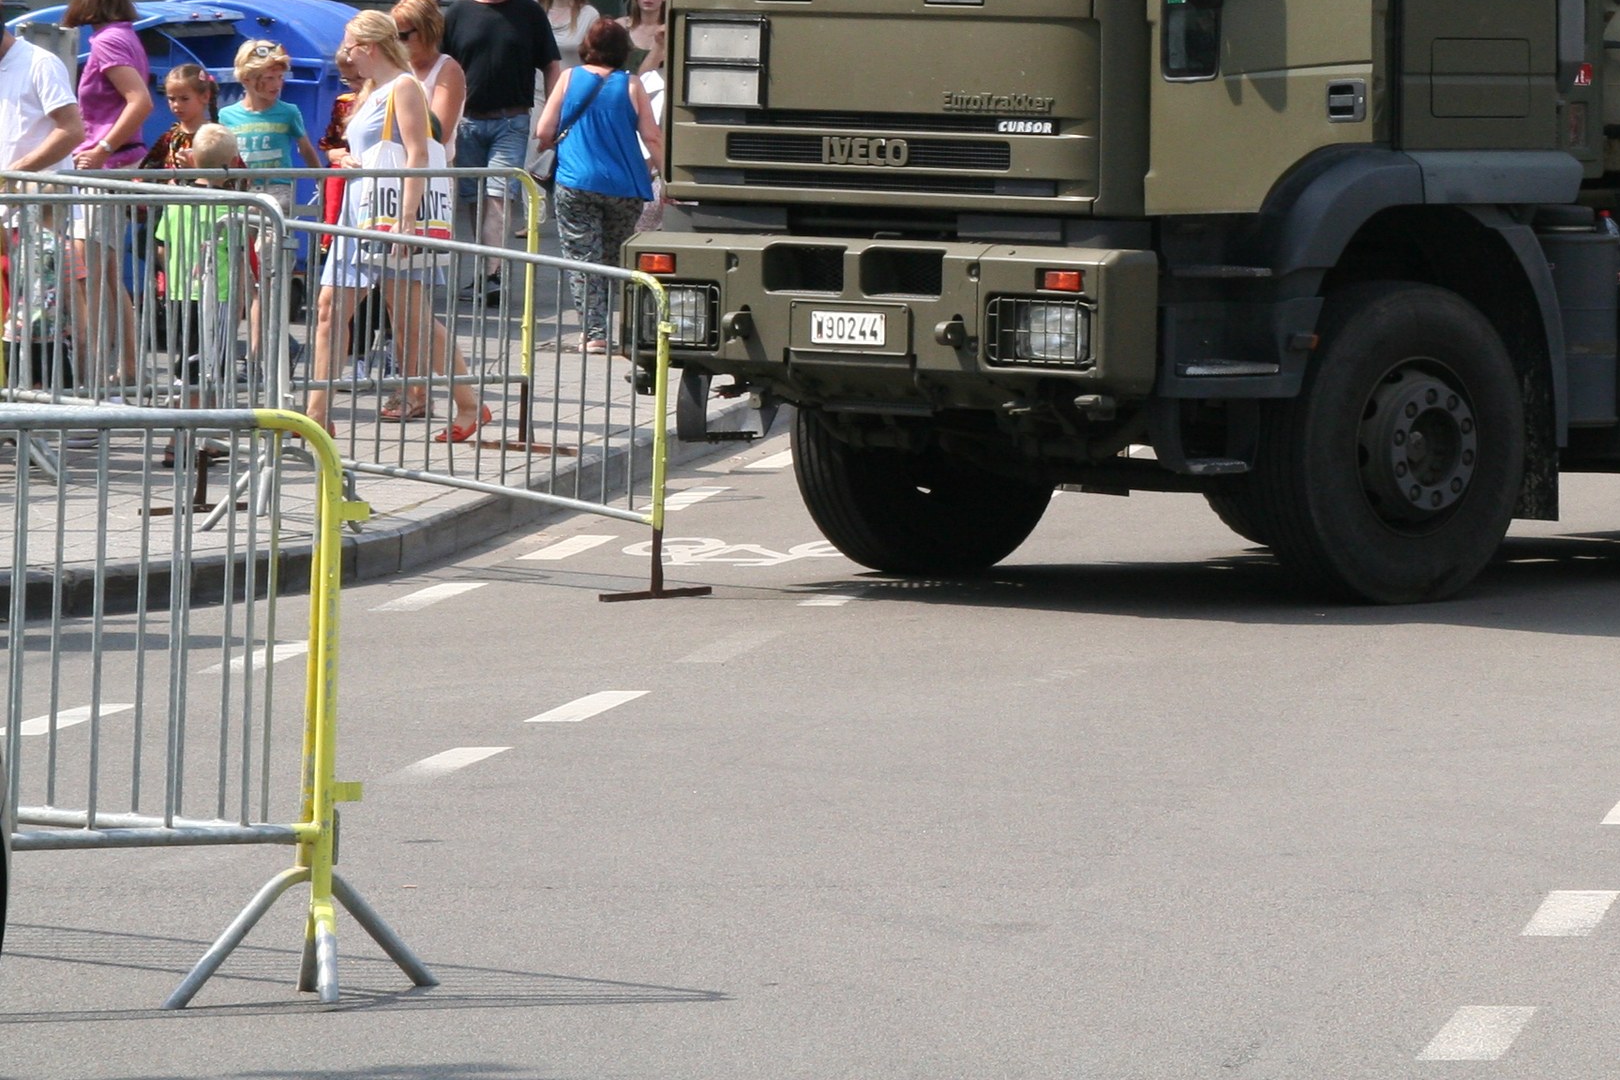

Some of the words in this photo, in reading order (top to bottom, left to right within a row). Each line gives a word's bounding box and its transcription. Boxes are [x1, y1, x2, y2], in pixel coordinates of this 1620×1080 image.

[942, 89, 1055, 114] EuroTrakker
[998, 121, 1053, 134] CURSOR
[822, 136, 909, 167] IVECO
